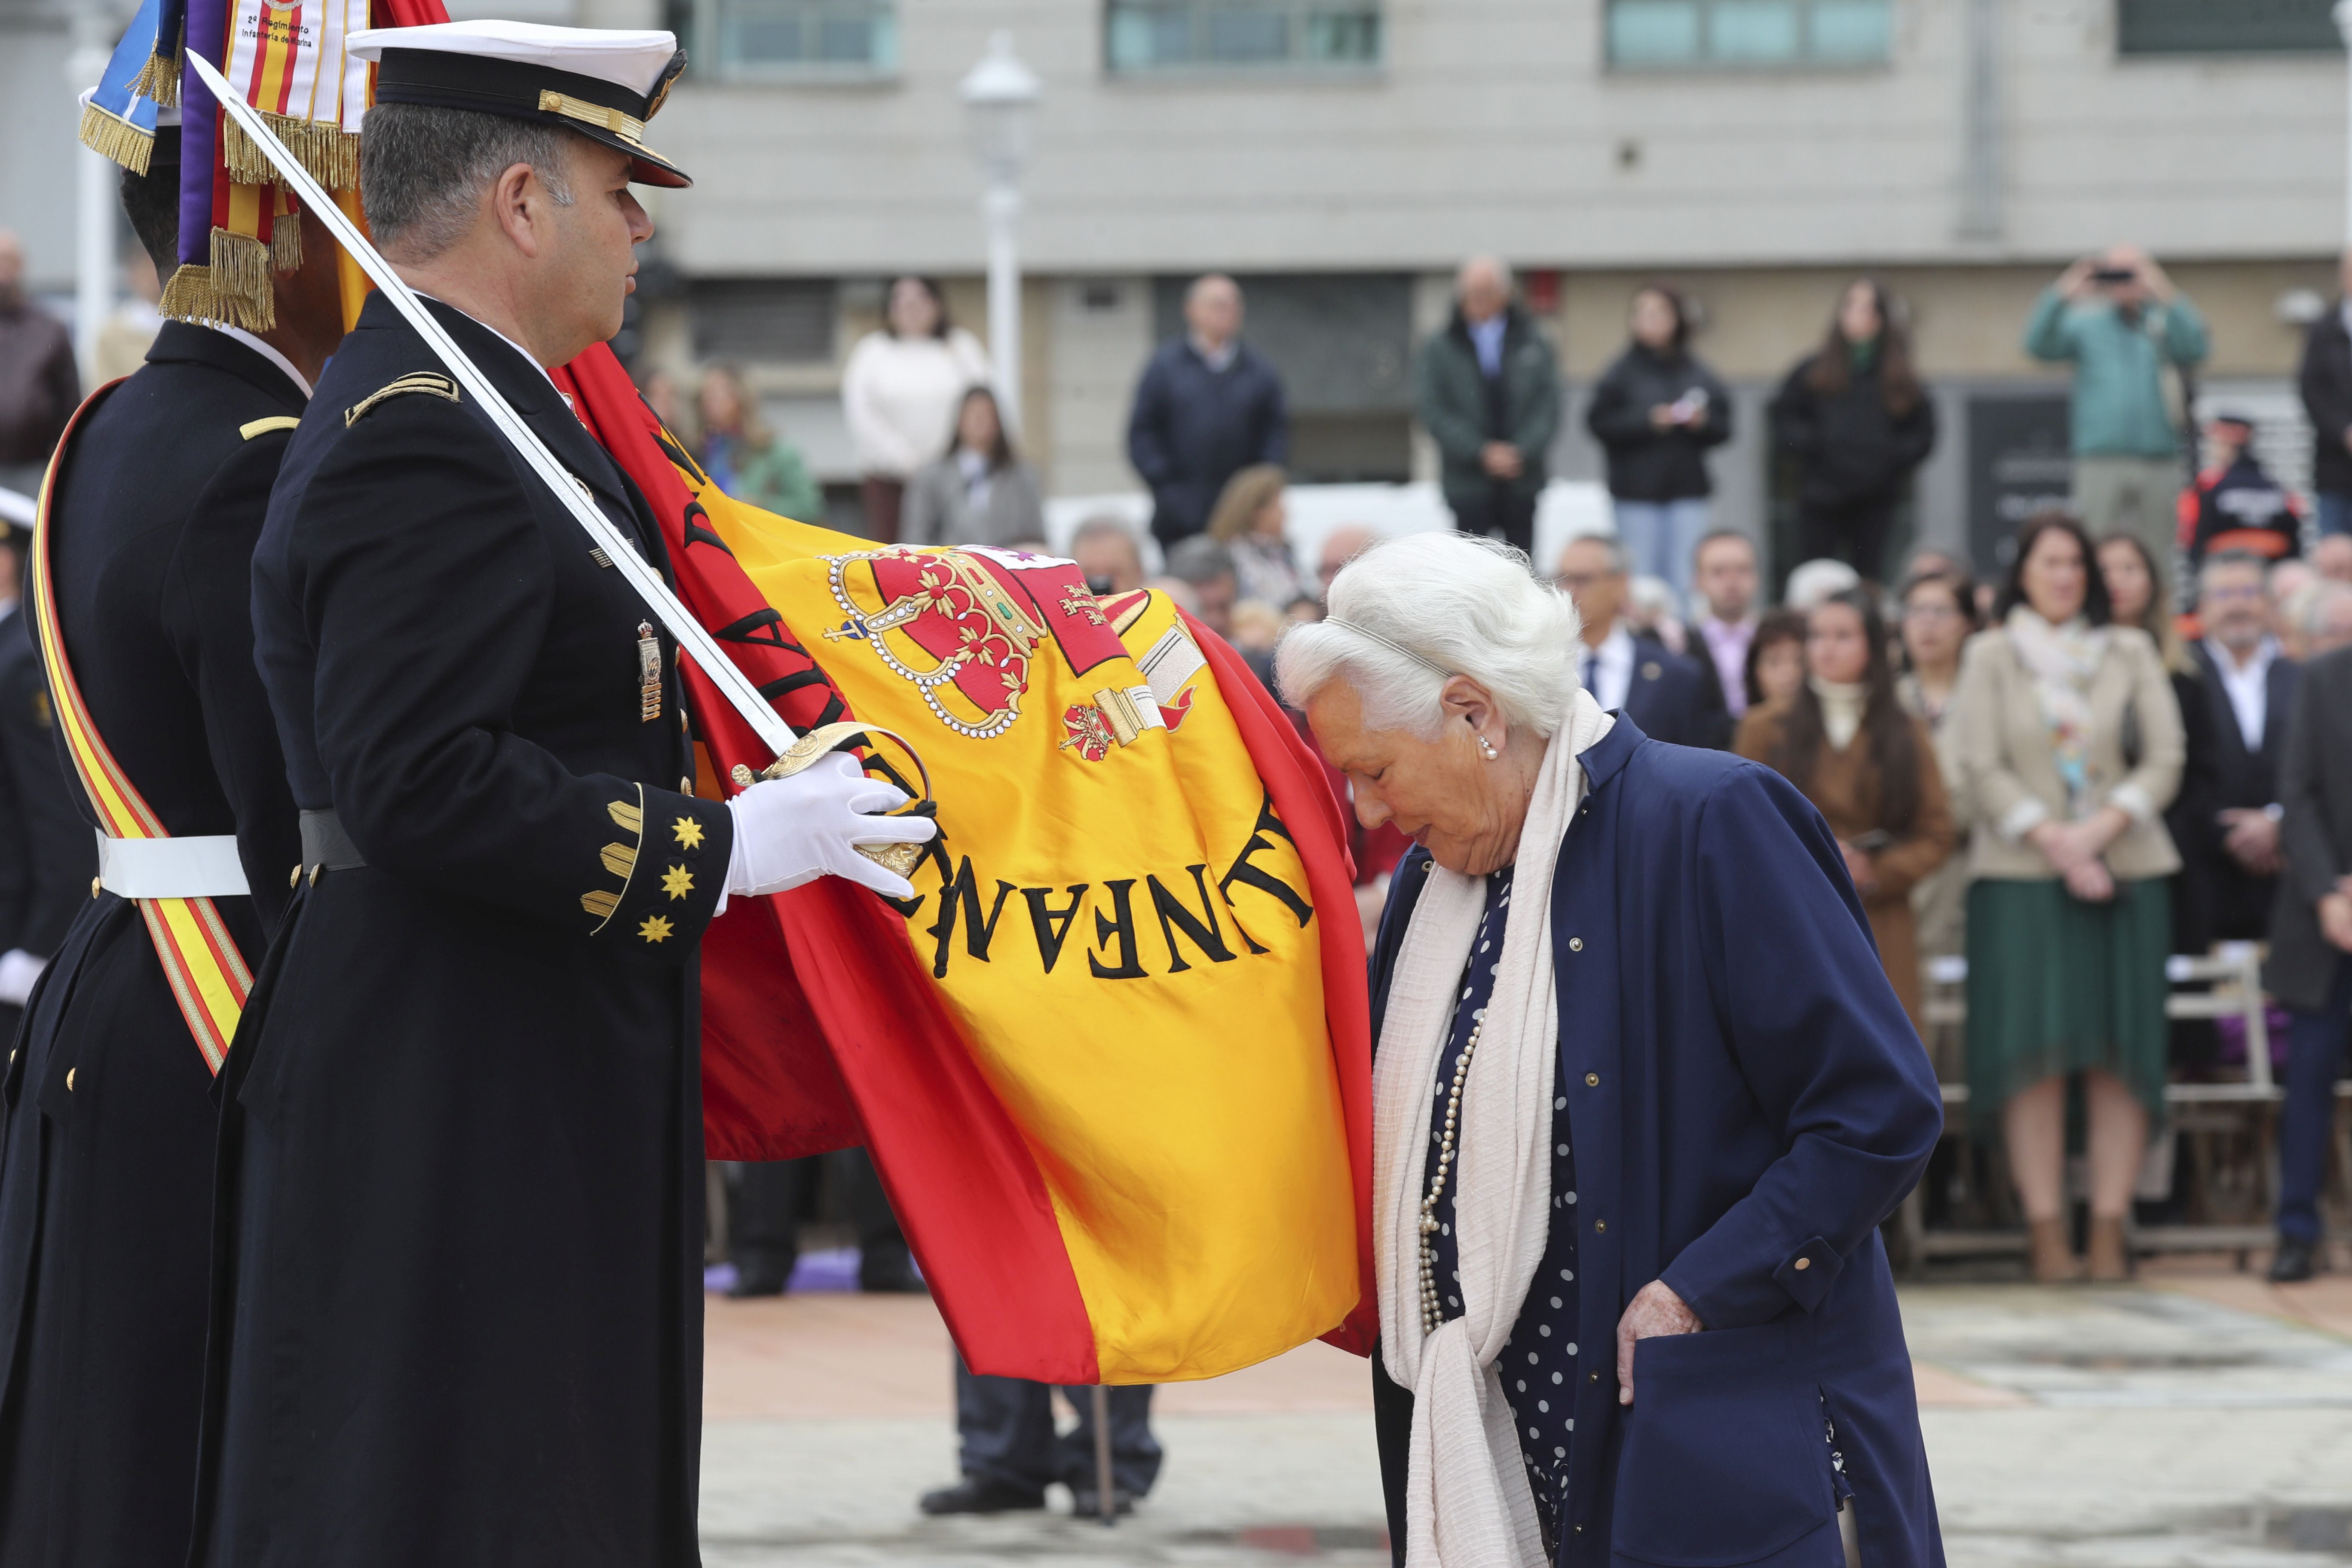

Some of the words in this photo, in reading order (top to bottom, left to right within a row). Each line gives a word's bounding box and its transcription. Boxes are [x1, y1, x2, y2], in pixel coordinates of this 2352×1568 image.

[262, 17, 309, 34] Regimiento
[242, 28, 278, 41] Infantería
[281, 35, 289, 43] de
[290, 37, 312, 47] Marina
